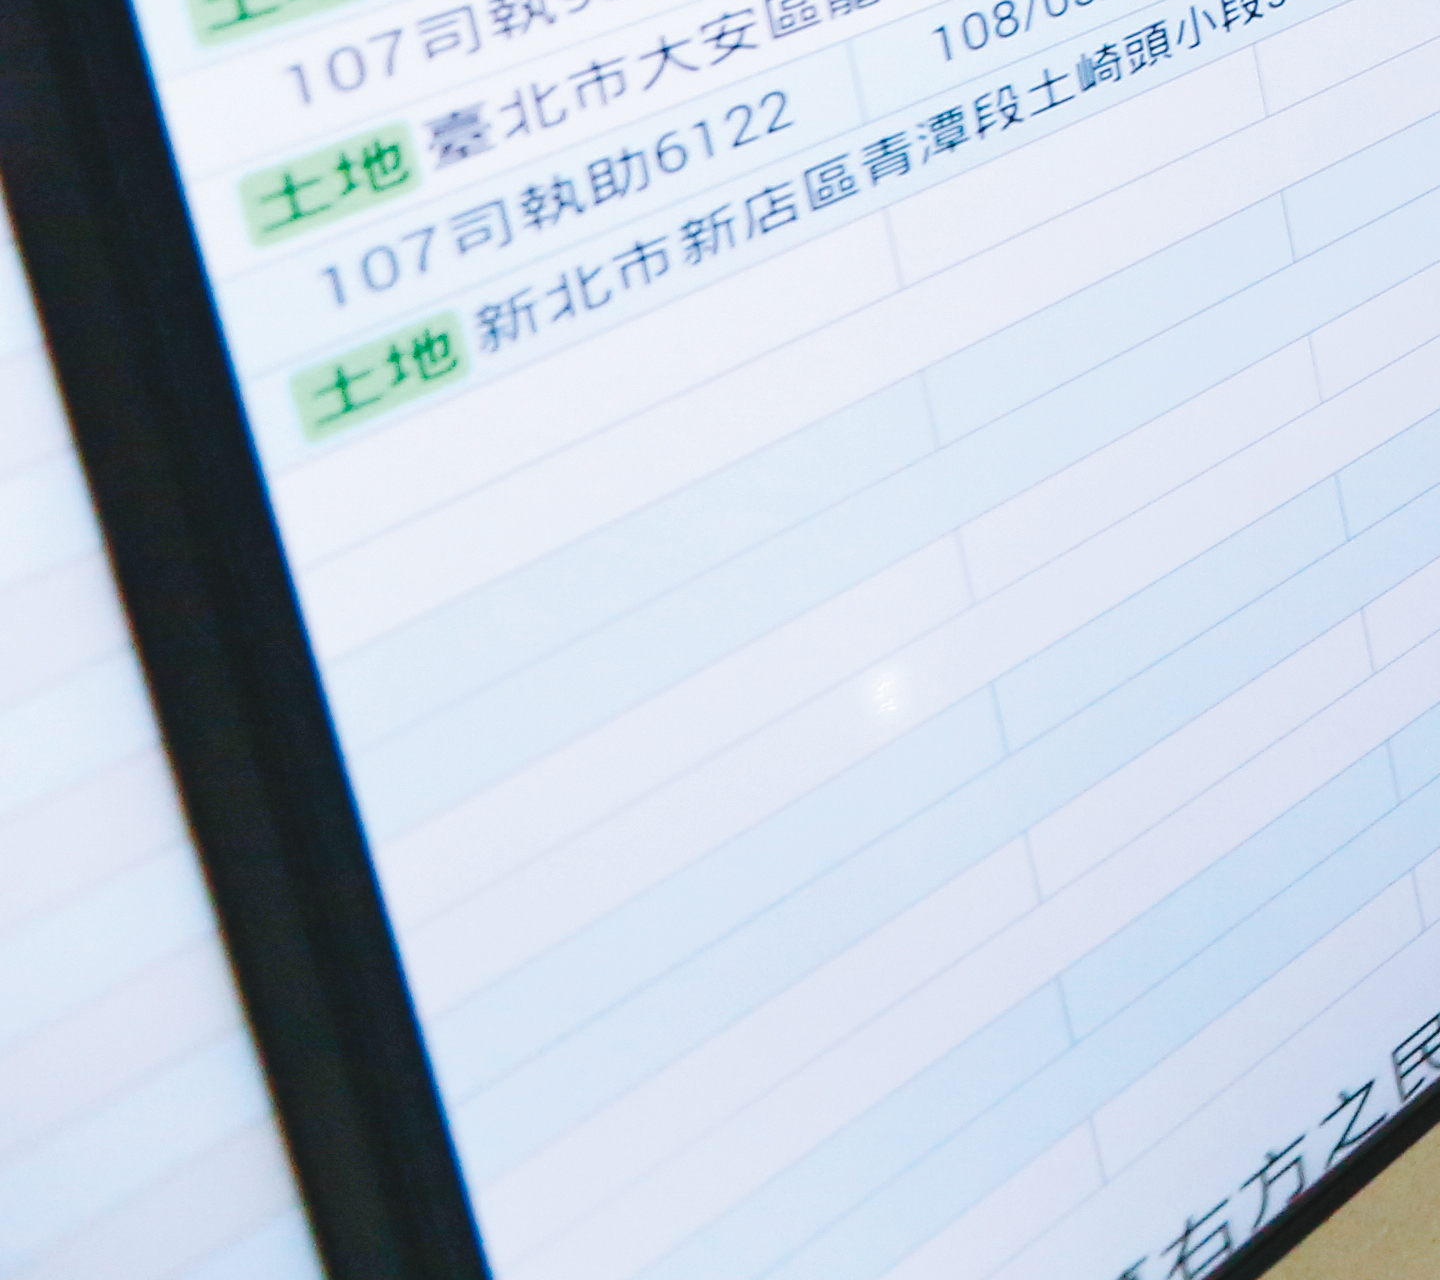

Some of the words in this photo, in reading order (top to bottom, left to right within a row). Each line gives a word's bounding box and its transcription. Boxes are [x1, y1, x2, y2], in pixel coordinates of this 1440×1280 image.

[255, 135, 415, 235] 土地
[318, 87, 798, 311] 107司執助6122
[311, 323, 462, 429] 土地
